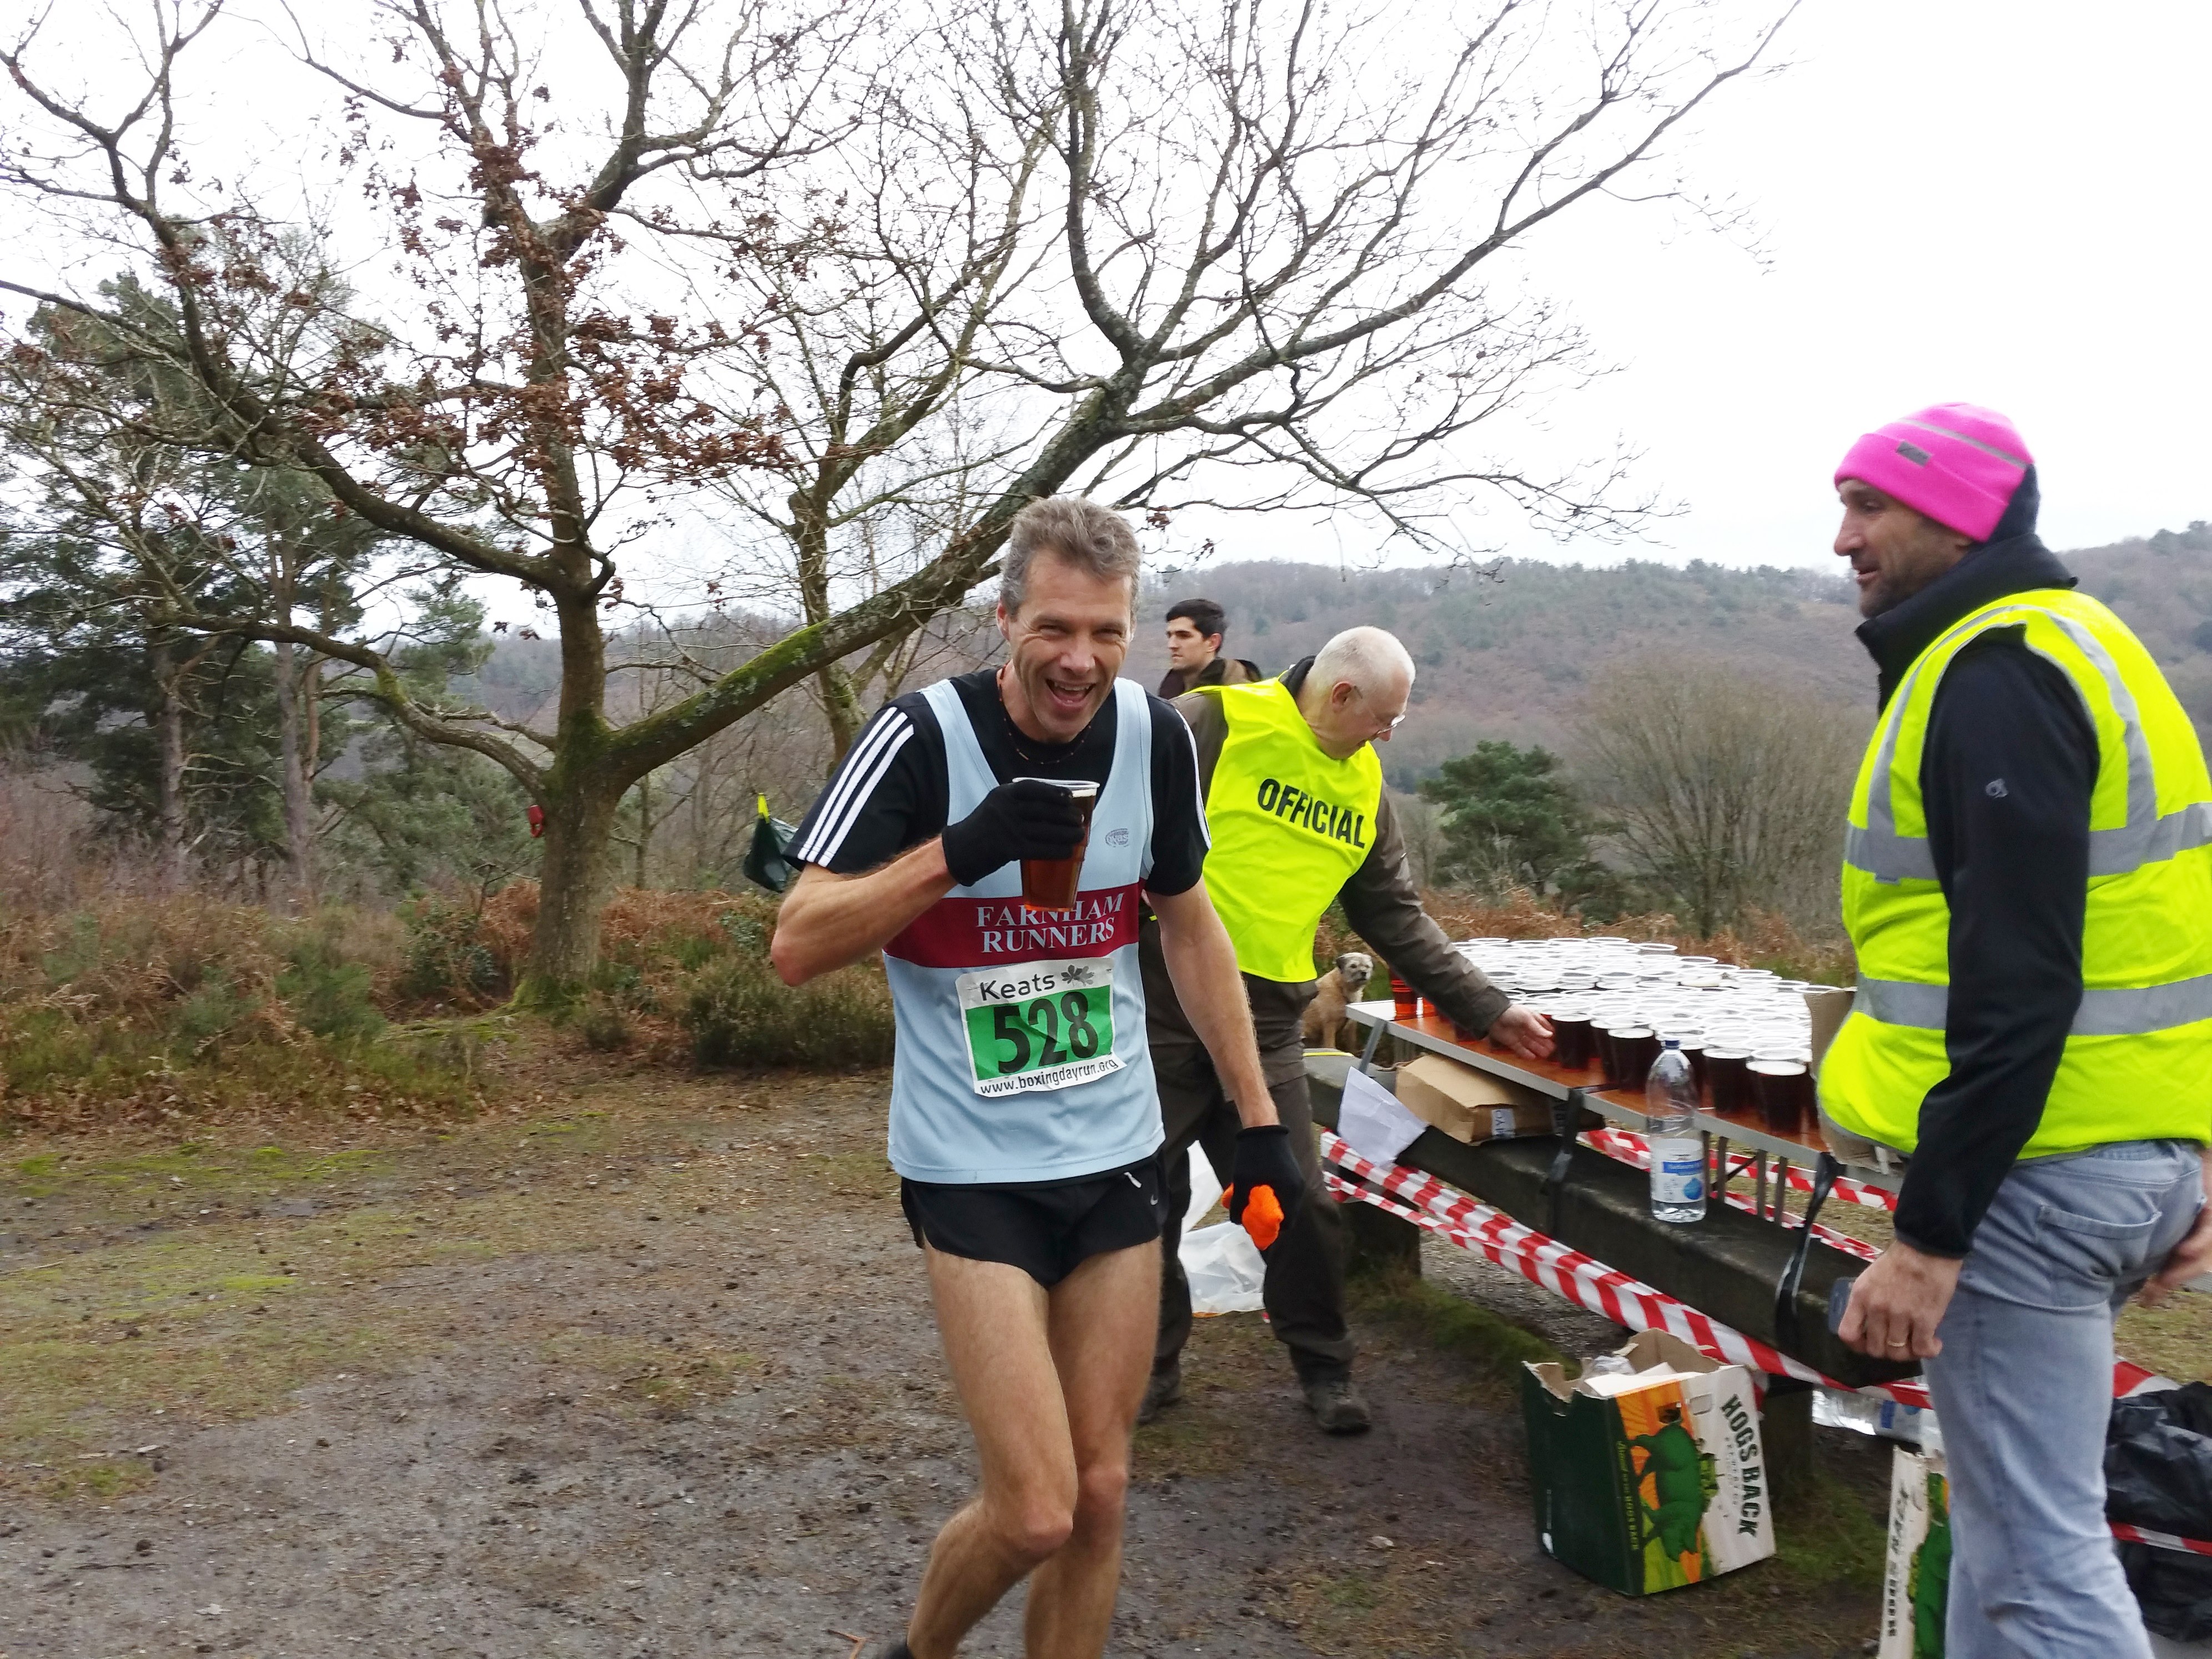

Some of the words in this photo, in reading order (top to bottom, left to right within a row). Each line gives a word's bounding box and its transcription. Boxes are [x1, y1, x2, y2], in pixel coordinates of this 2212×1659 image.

[1258, 778, 1365, 848] OFFICIAL
[982, 917, 1114, 953] RUNNERS
[980, 974, 1055, 1001] Keats
[993, 991, 1098, 1074] 528
[981, 1058, 1119, 1094] www.boxingdayrun.org
[1721, 1394, 1758, 1462] HOGS
[1738, 1466, 1762, 1537] BACK
